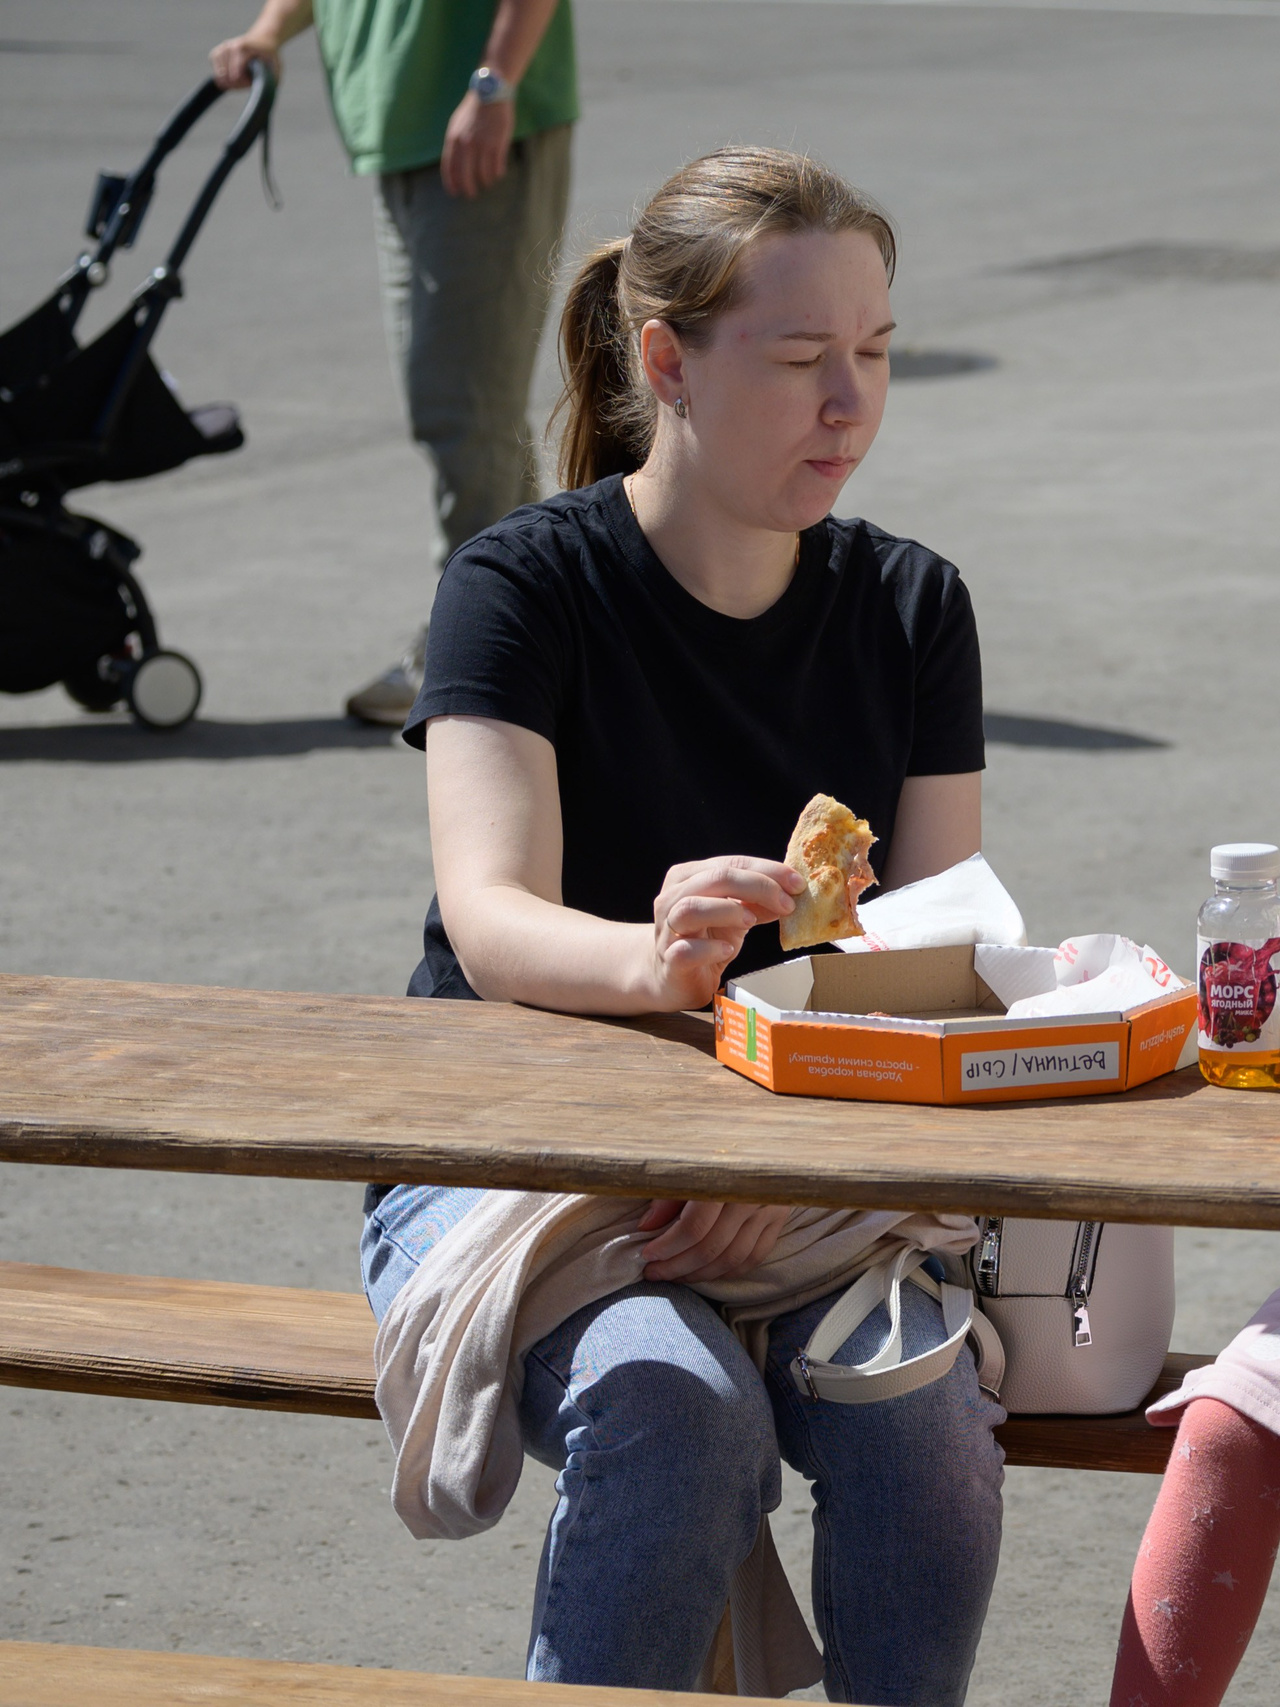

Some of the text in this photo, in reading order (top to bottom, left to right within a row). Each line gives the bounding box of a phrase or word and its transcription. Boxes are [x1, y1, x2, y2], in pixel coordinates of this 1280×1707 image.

[1210, 984, 1254, 999] МОРС
[1211, 999, 1253, 1010] ЯГОДНЫЙ
[1139, 1023, 1185, 1052] sushi-pizzi.ru
[788, 1052, 835, 1064] крышку!
[837, 1057, 873, 1067] сними
[875, 1060, 913, 1071] просто
[808, 1066, 903, 1082] Удобная коробка
